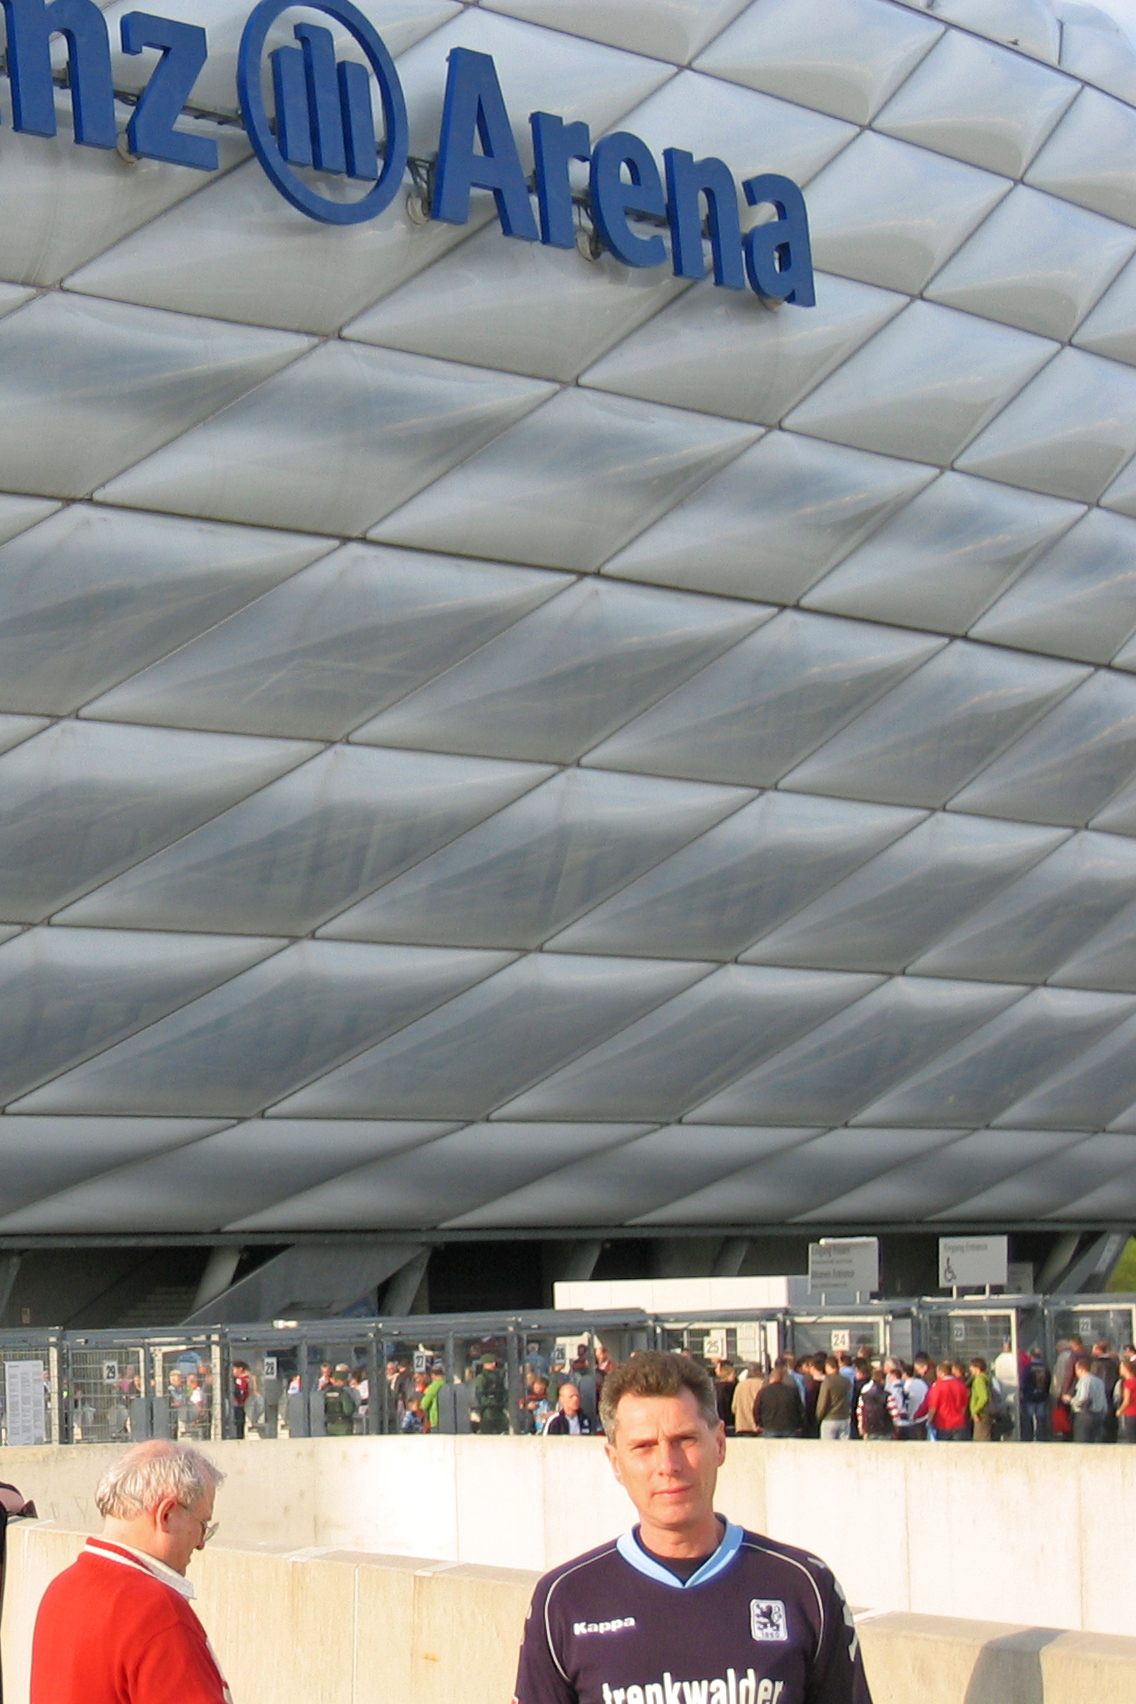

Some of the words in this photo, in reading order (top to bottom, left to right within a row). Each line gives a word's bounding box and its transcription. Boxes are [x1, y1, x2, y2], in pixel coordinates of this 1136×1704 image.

[431, 46, 816, 308] Arena
[833, 1333, 846, 1345] 24
[706, 1340, 720, 1353] 25
[415, 1355, 424, 1368] 27
[106, 1364, 116, 1379] 29
[573, 1617, 636, 1635] Kappa
